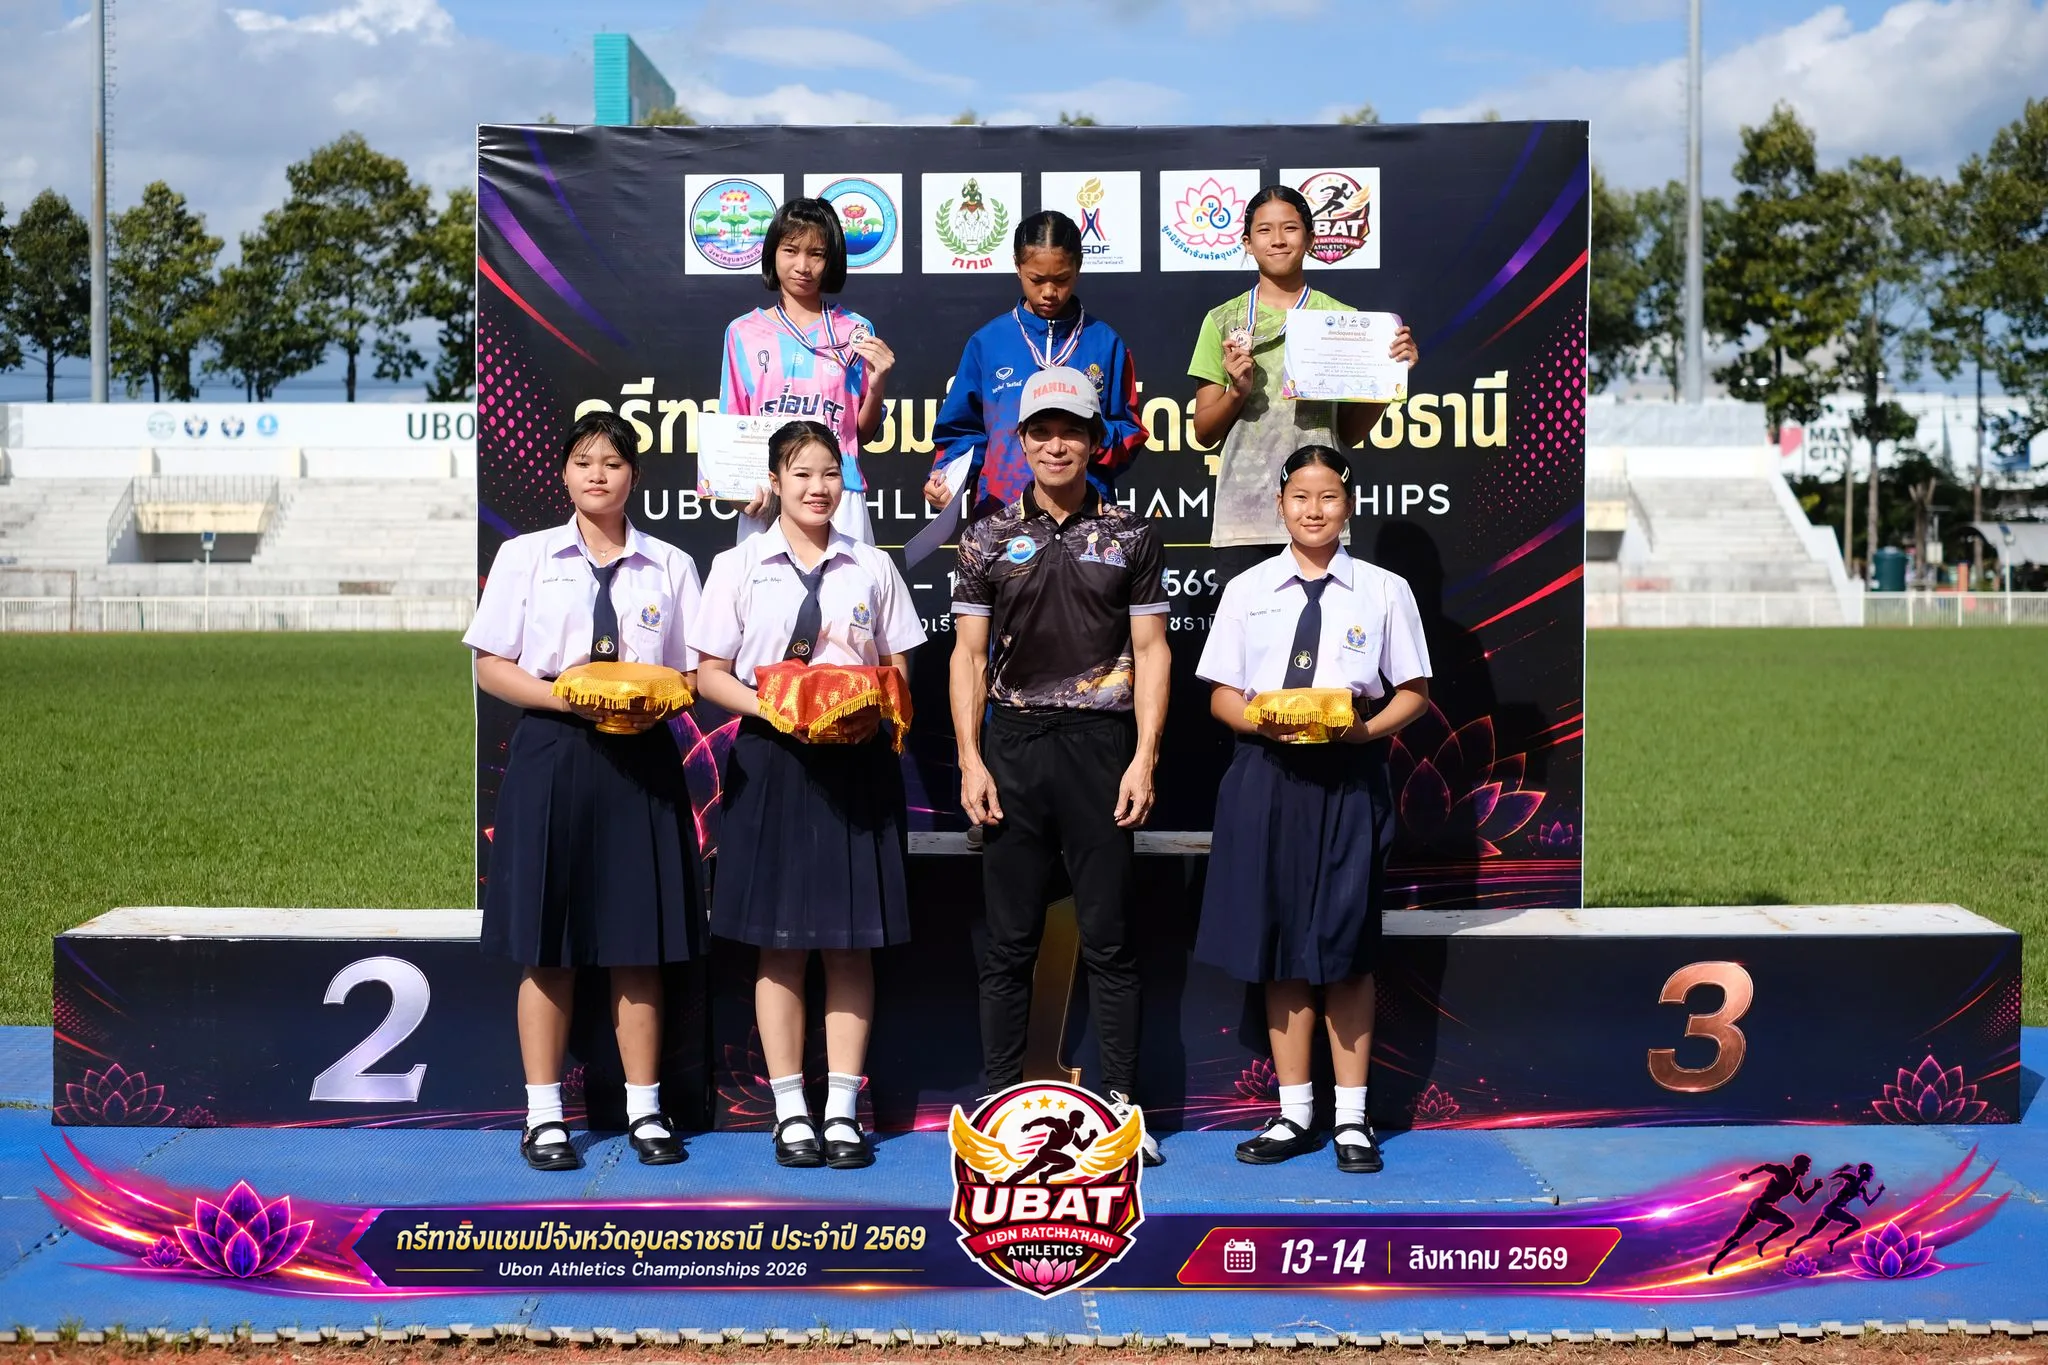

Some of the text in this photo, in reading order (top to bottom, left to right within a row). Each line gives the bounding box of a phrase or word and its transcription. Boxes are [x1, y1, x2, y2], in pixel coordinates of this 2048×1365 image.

[1314, 220, 1365, 237] BAT
[1081, 244, 1111, 254] SDF
[1033, 382, 1078, 400] MANILA
[309, 955, 432, 1103] 2
[1646, 960, 1755, 1093] 3
